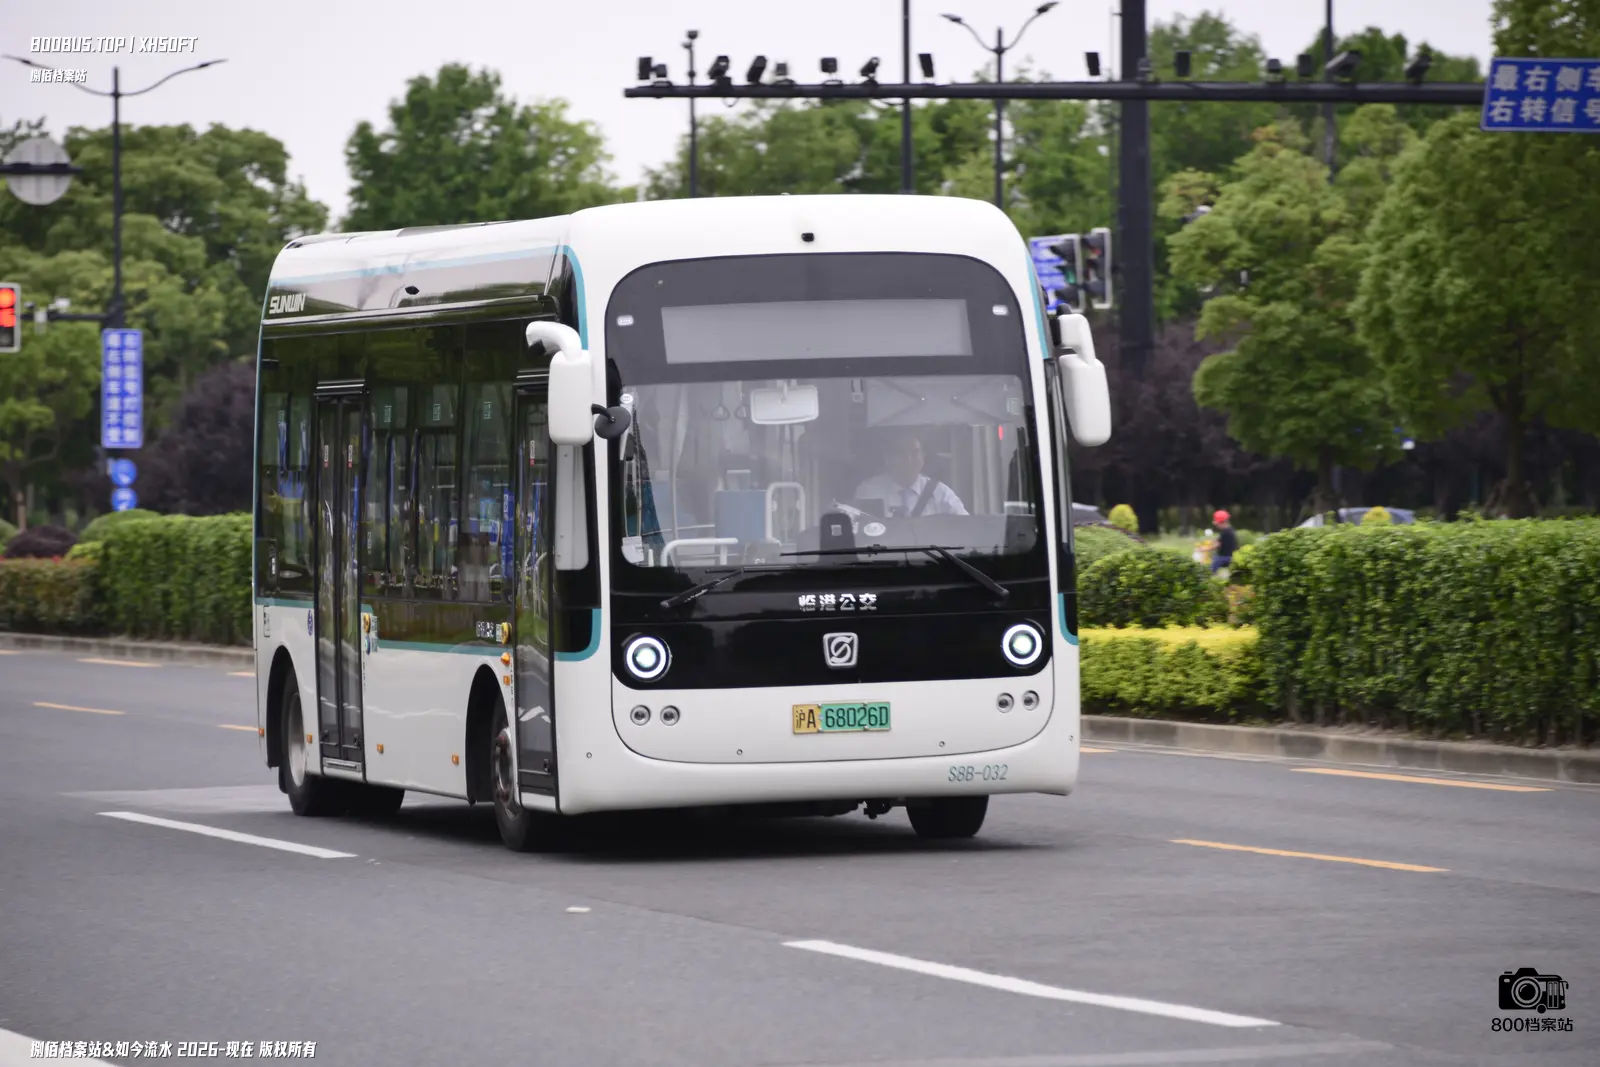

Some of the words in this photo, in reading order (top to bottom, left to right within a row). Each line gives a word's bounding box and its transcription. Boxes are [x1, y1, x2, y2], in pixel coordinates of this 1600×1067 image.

[798, 592, 877, 612] 临港公交
[948, 764, 1009, 783] S8B-032
